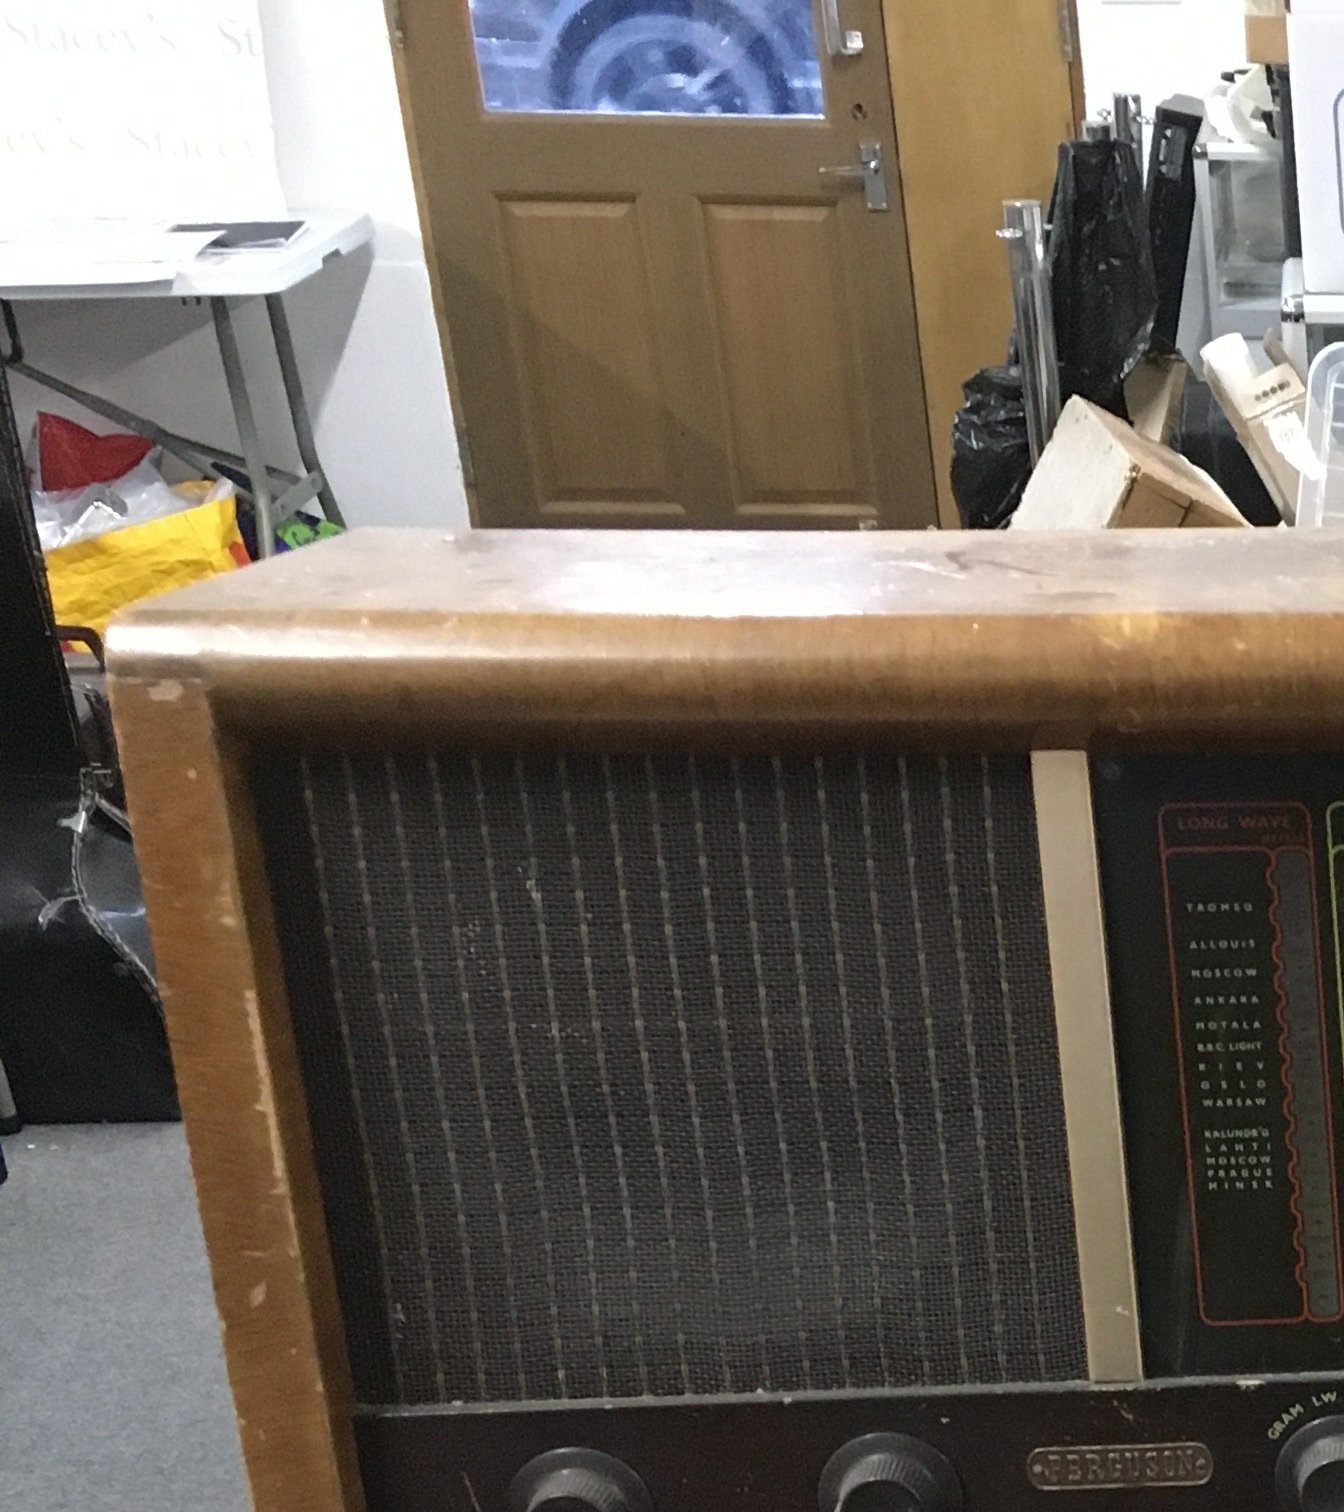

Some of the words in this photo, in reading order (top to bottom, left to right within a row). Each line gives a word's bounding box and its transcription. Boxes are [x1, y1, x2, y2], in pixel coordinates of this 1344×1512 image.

[1179, 815, 1228, 830] LONG
[1238, 814, 1290, 830] WAVE
[1267, 1402, 1305, 1440] GRAM
[1311, 1390, 1337, 1407] LW
[1044, 1449, 1196, 1484] FERGUSON
